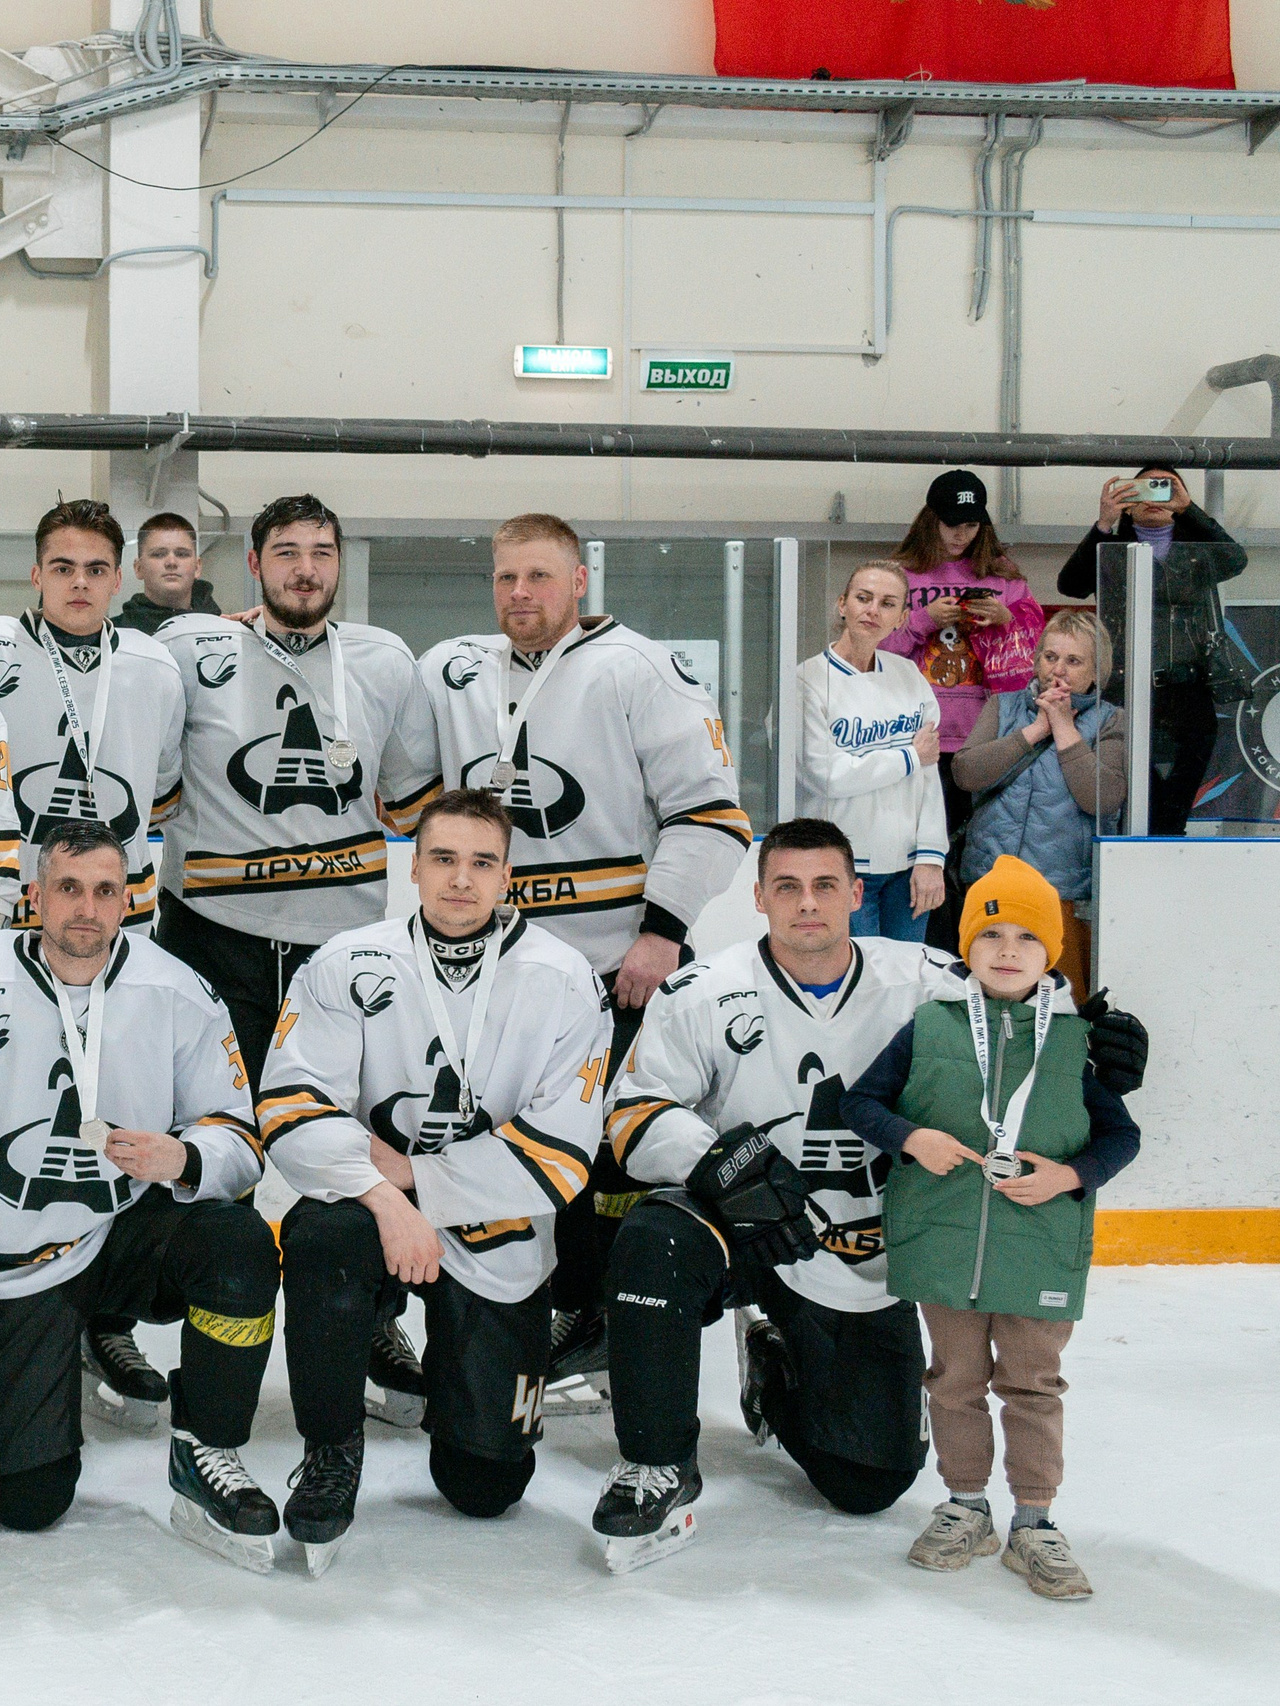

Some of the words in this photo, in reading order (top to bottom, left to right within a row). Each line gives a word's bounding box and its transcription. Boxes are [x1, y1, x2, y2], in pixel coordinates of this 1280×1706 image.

[537, 350, 592, 363] ВЫХОД
[650, 368, 727, 387] ВЫХОД
[272, 646, 288, 663] ЛИГА
[41, 632, 56, 656] НОЧНАЯ
[51, 657, 63, 674] ЛИГА
[58, 676, 71, 698] СЕЗОН
[65, 699, 80, 729] 2024/25
[242, 850, 366, 881] ДРУЖБА
[503, 876, 578, 906] ЖБА
[970, 992, 983, 1024] НОЧНАЯ
[1037, 984, 1051, 1031] ЧЕМПИОНАТ
[975, 1027, 985, 1046] ЛИГА
[716, 1132, 775, 1189] BAU
